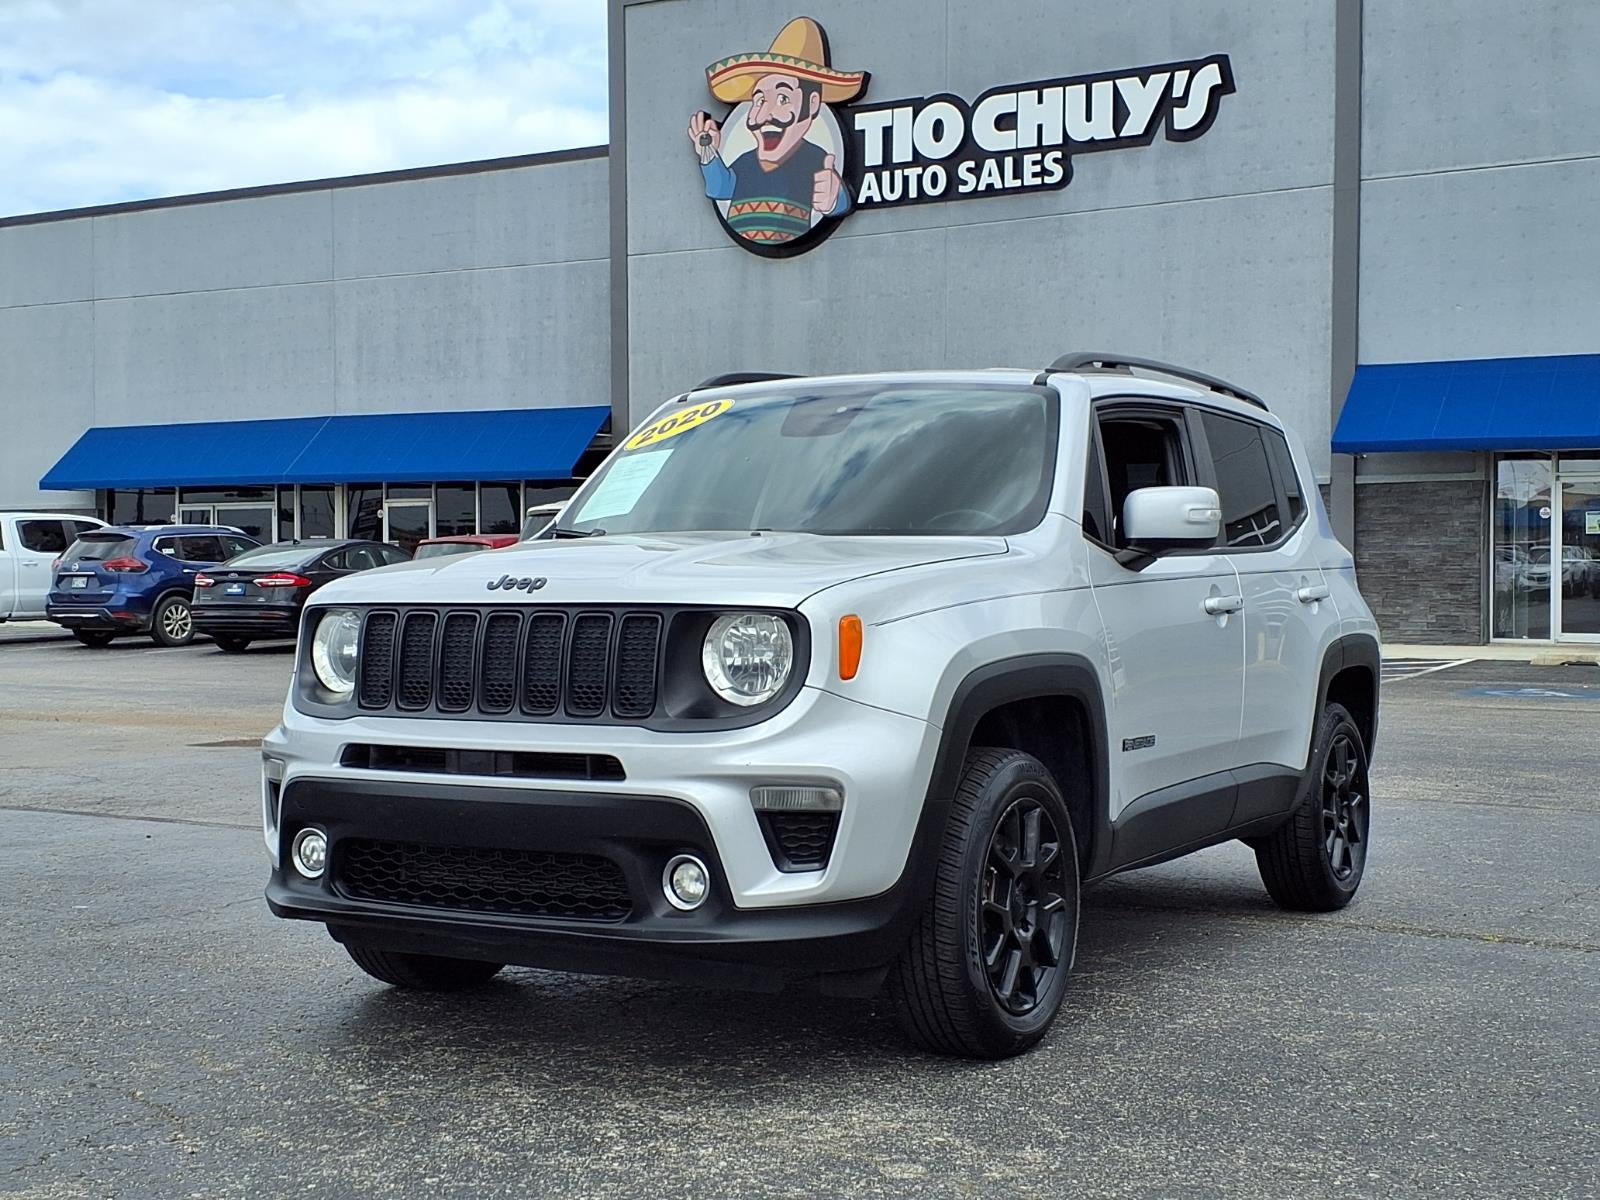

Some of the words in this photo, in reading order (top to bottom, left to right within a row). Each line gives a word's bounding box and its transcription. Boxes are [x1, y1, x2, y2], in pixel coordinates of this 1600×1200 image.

[855, 103, 964, 167] TIO
[972, 64, 1222, 152] CHUY'S
[857, 166, 947, 204] AUTO
[957, 152, 1063, 193] SALES
[635, 402, 722, 446] 2020
[486, 574, 548, 594] Jeep
